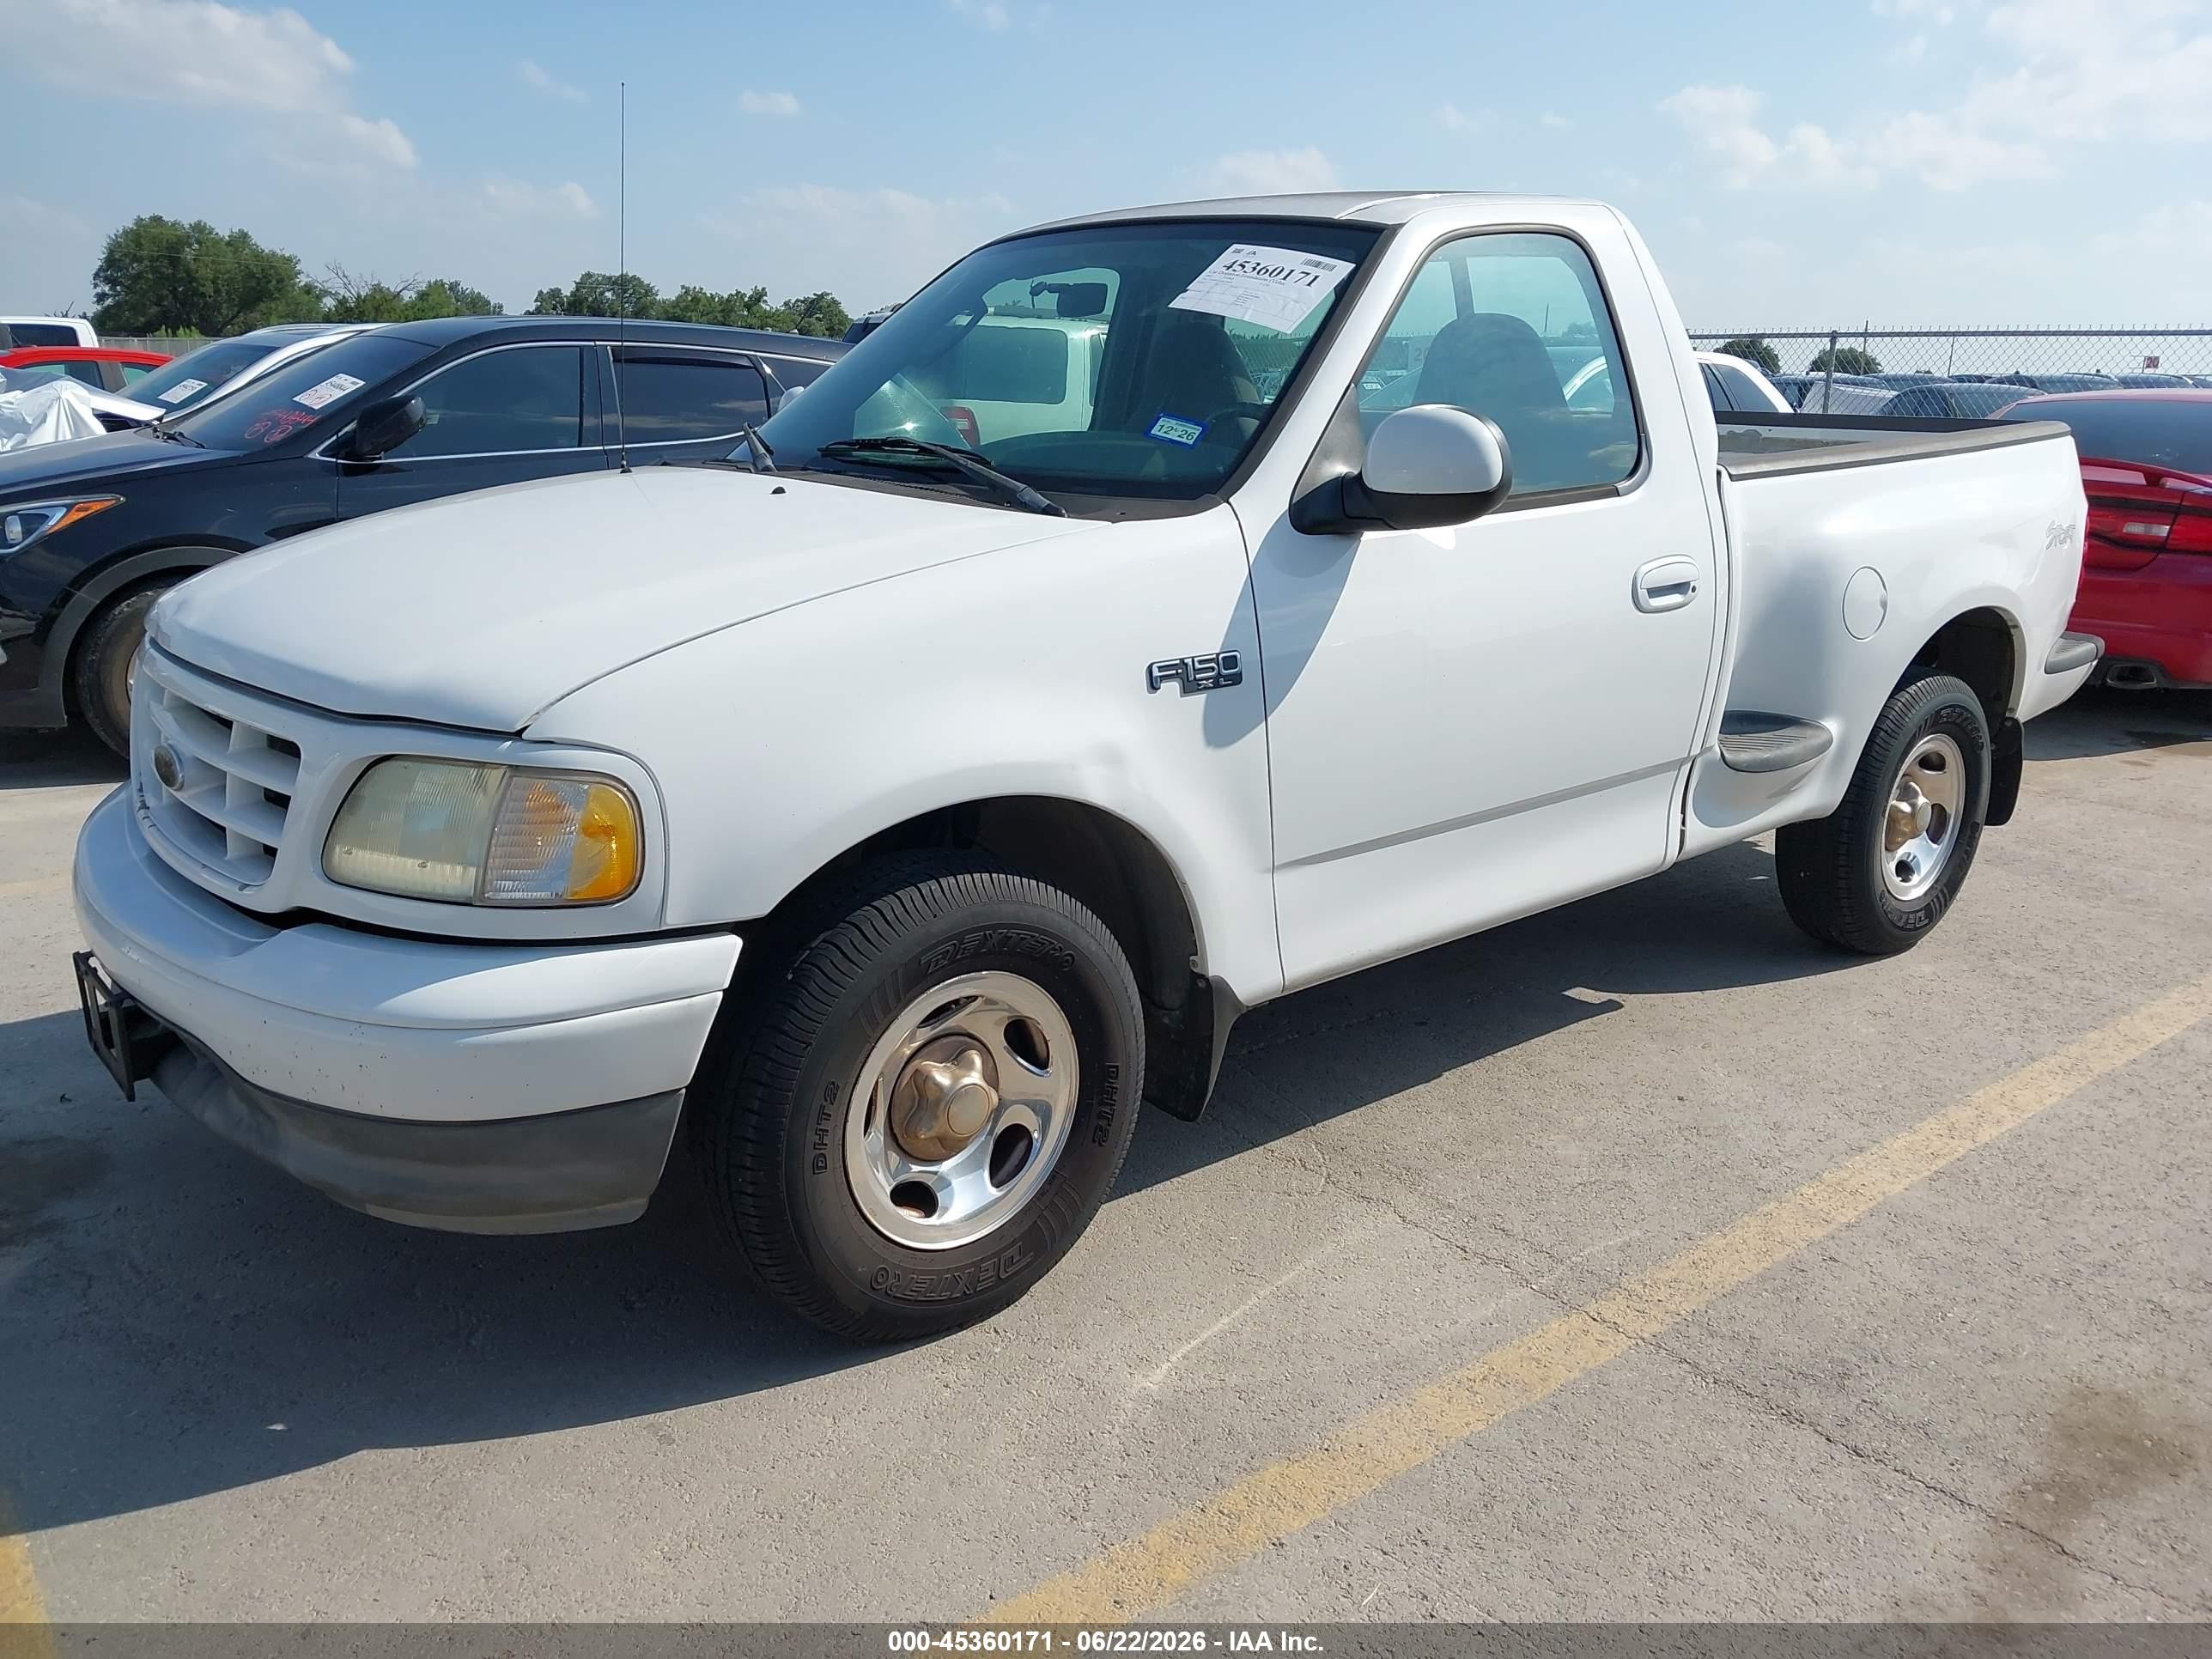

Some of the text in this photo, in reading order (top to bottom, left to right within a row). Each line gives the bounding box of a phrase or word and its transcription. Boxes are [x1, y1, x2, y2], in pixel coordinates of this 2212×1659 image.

[1222, 259, 1321, 288] 45360171
[1157, 423, 1175, 435] 12
[1176, 428, 1197, 441] 26
[1197, 677, 1234, 690] XL
[920, 929, 1075, 975] DEXTERO
[812, 1080, 841, 1175] DHT2
[1092, 1062, 1121, 1147] DHT2
[870, 1242, 1034, 1302] DEXTERO
